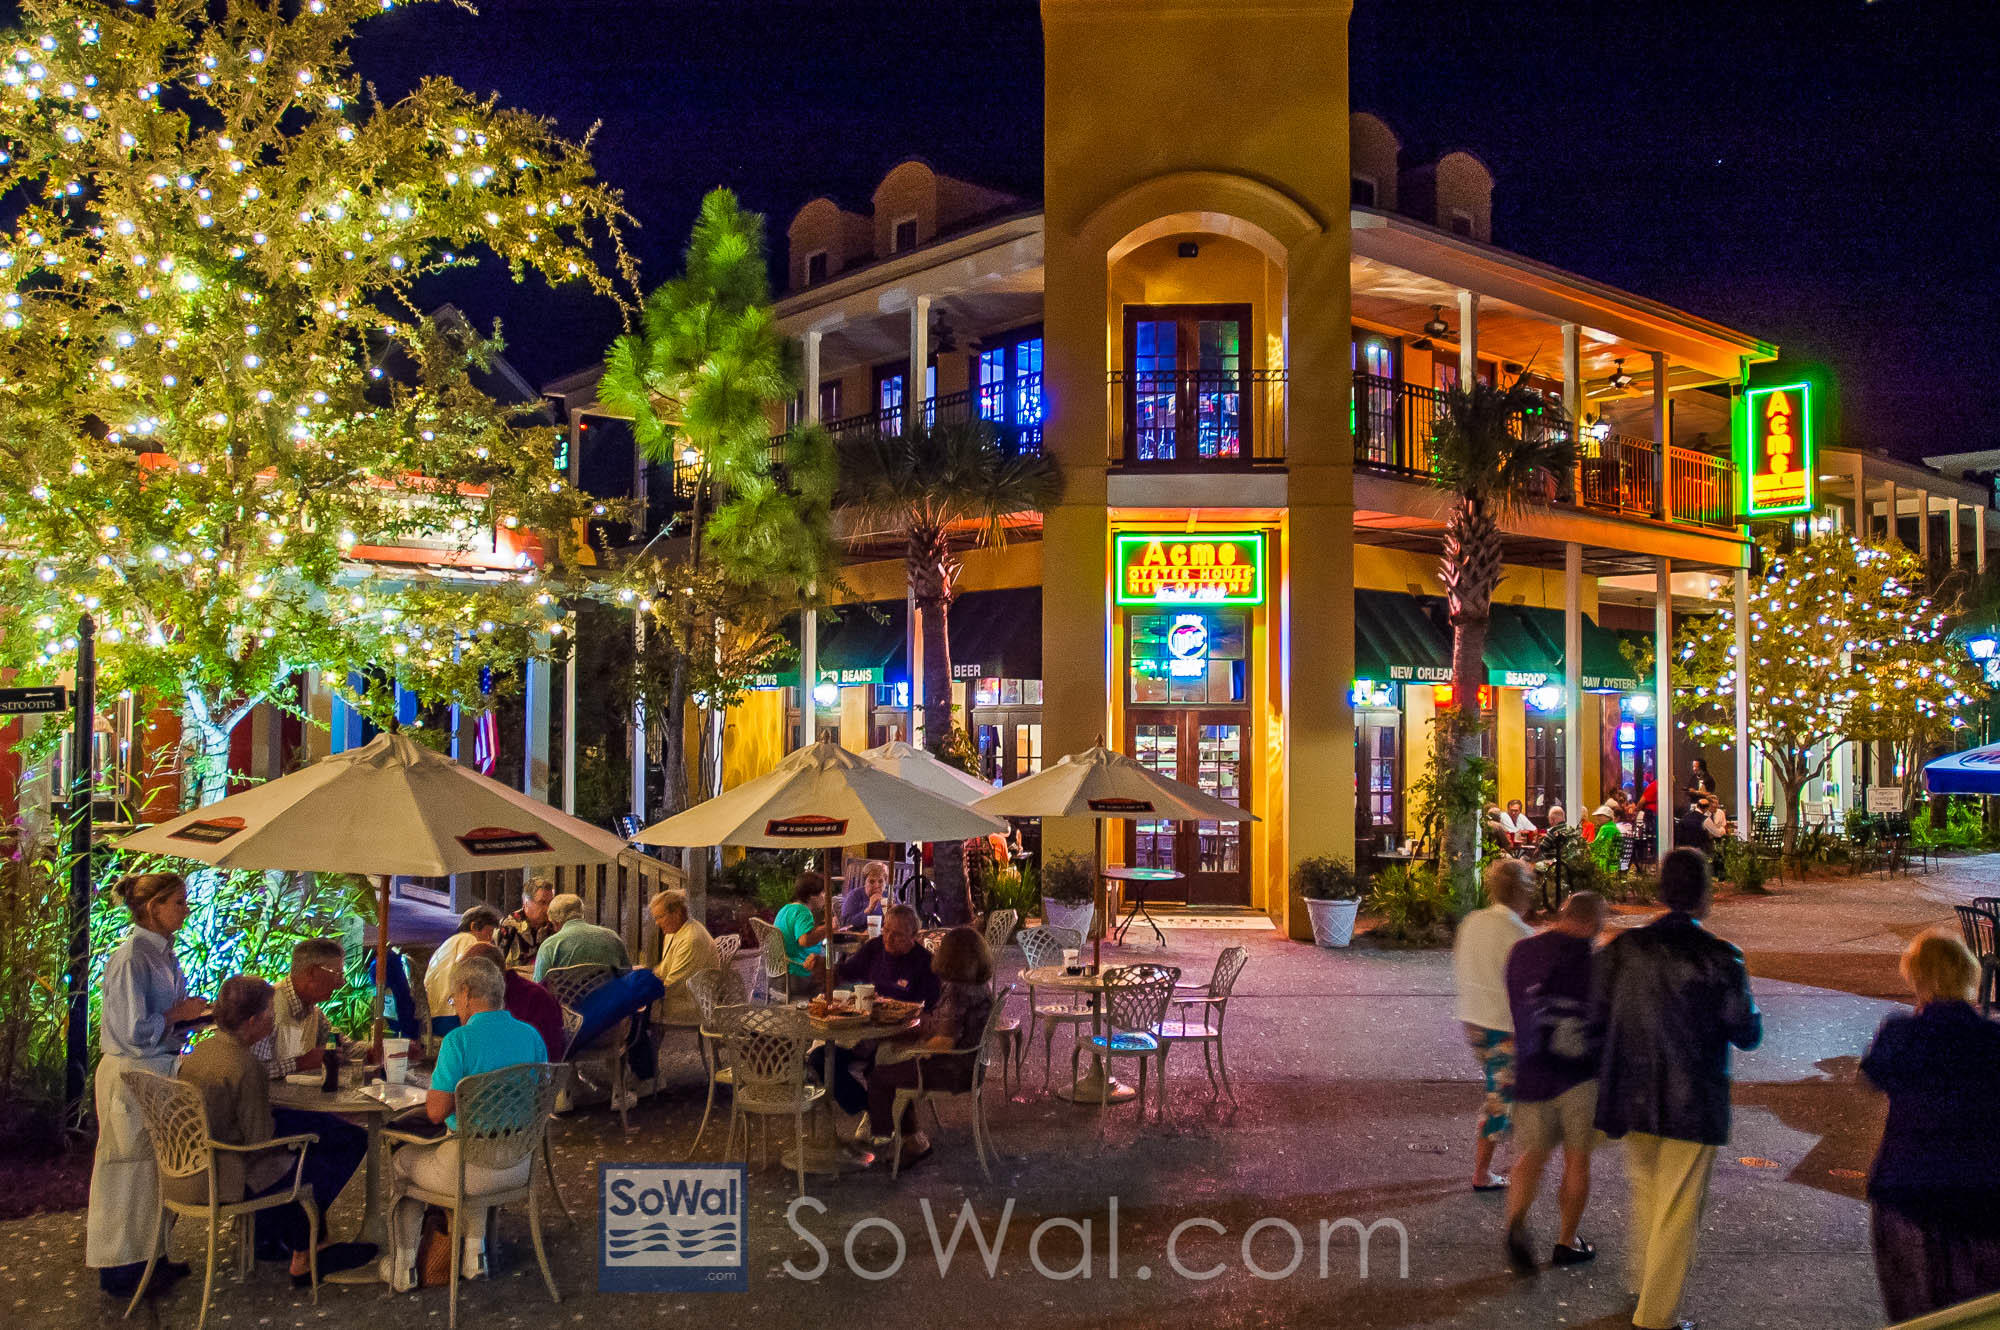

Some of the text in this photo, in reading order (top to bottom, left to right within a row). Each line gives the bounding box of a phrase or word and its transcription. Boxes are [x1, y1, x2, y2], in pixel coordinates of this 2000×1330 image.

[1129, 567, 1252, 580] OYSTER HOUSE
[841, 669, 872, 682] BEANS
[954, 664, 981, 677] BEER
[1390, 666, 1454, 681] NEW ORLEAN
[756, 674, 777, 686] BOYS
[1582, 676, 1600, 688] RAW
[1603, 677, 1637, 689] OYSTERS
[0, 699, 56, 711] strooms
